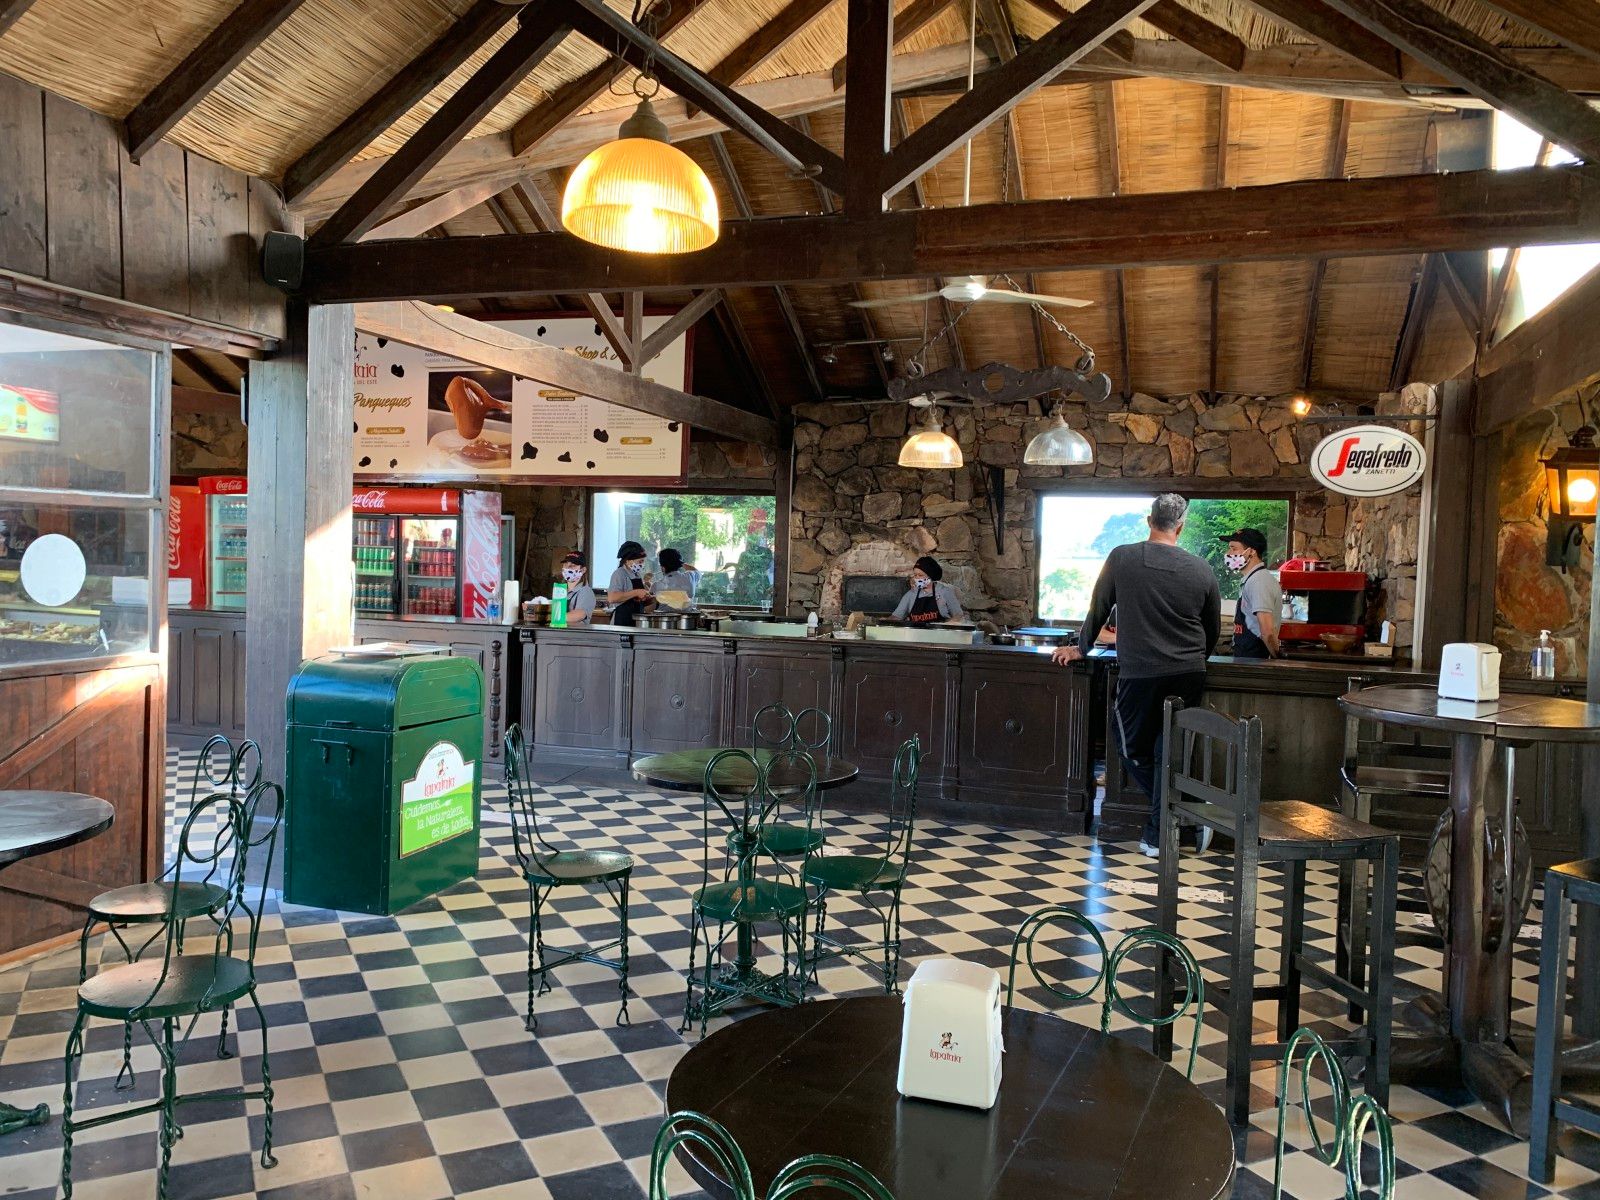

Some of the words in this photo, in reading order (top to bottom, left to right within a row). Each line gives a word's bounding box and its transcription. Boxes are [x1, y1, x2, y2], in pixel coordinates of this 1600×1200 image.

[600, 346, 608, 360] &
[353, 392, 412, 413] Panqueques
[1327, 437, 1412, 477] Segafredo
[352, 490, 389, 508] ca-Cola
[404, 799, 441, 820] Cuidemos
[417, 818, 424, 831] la
